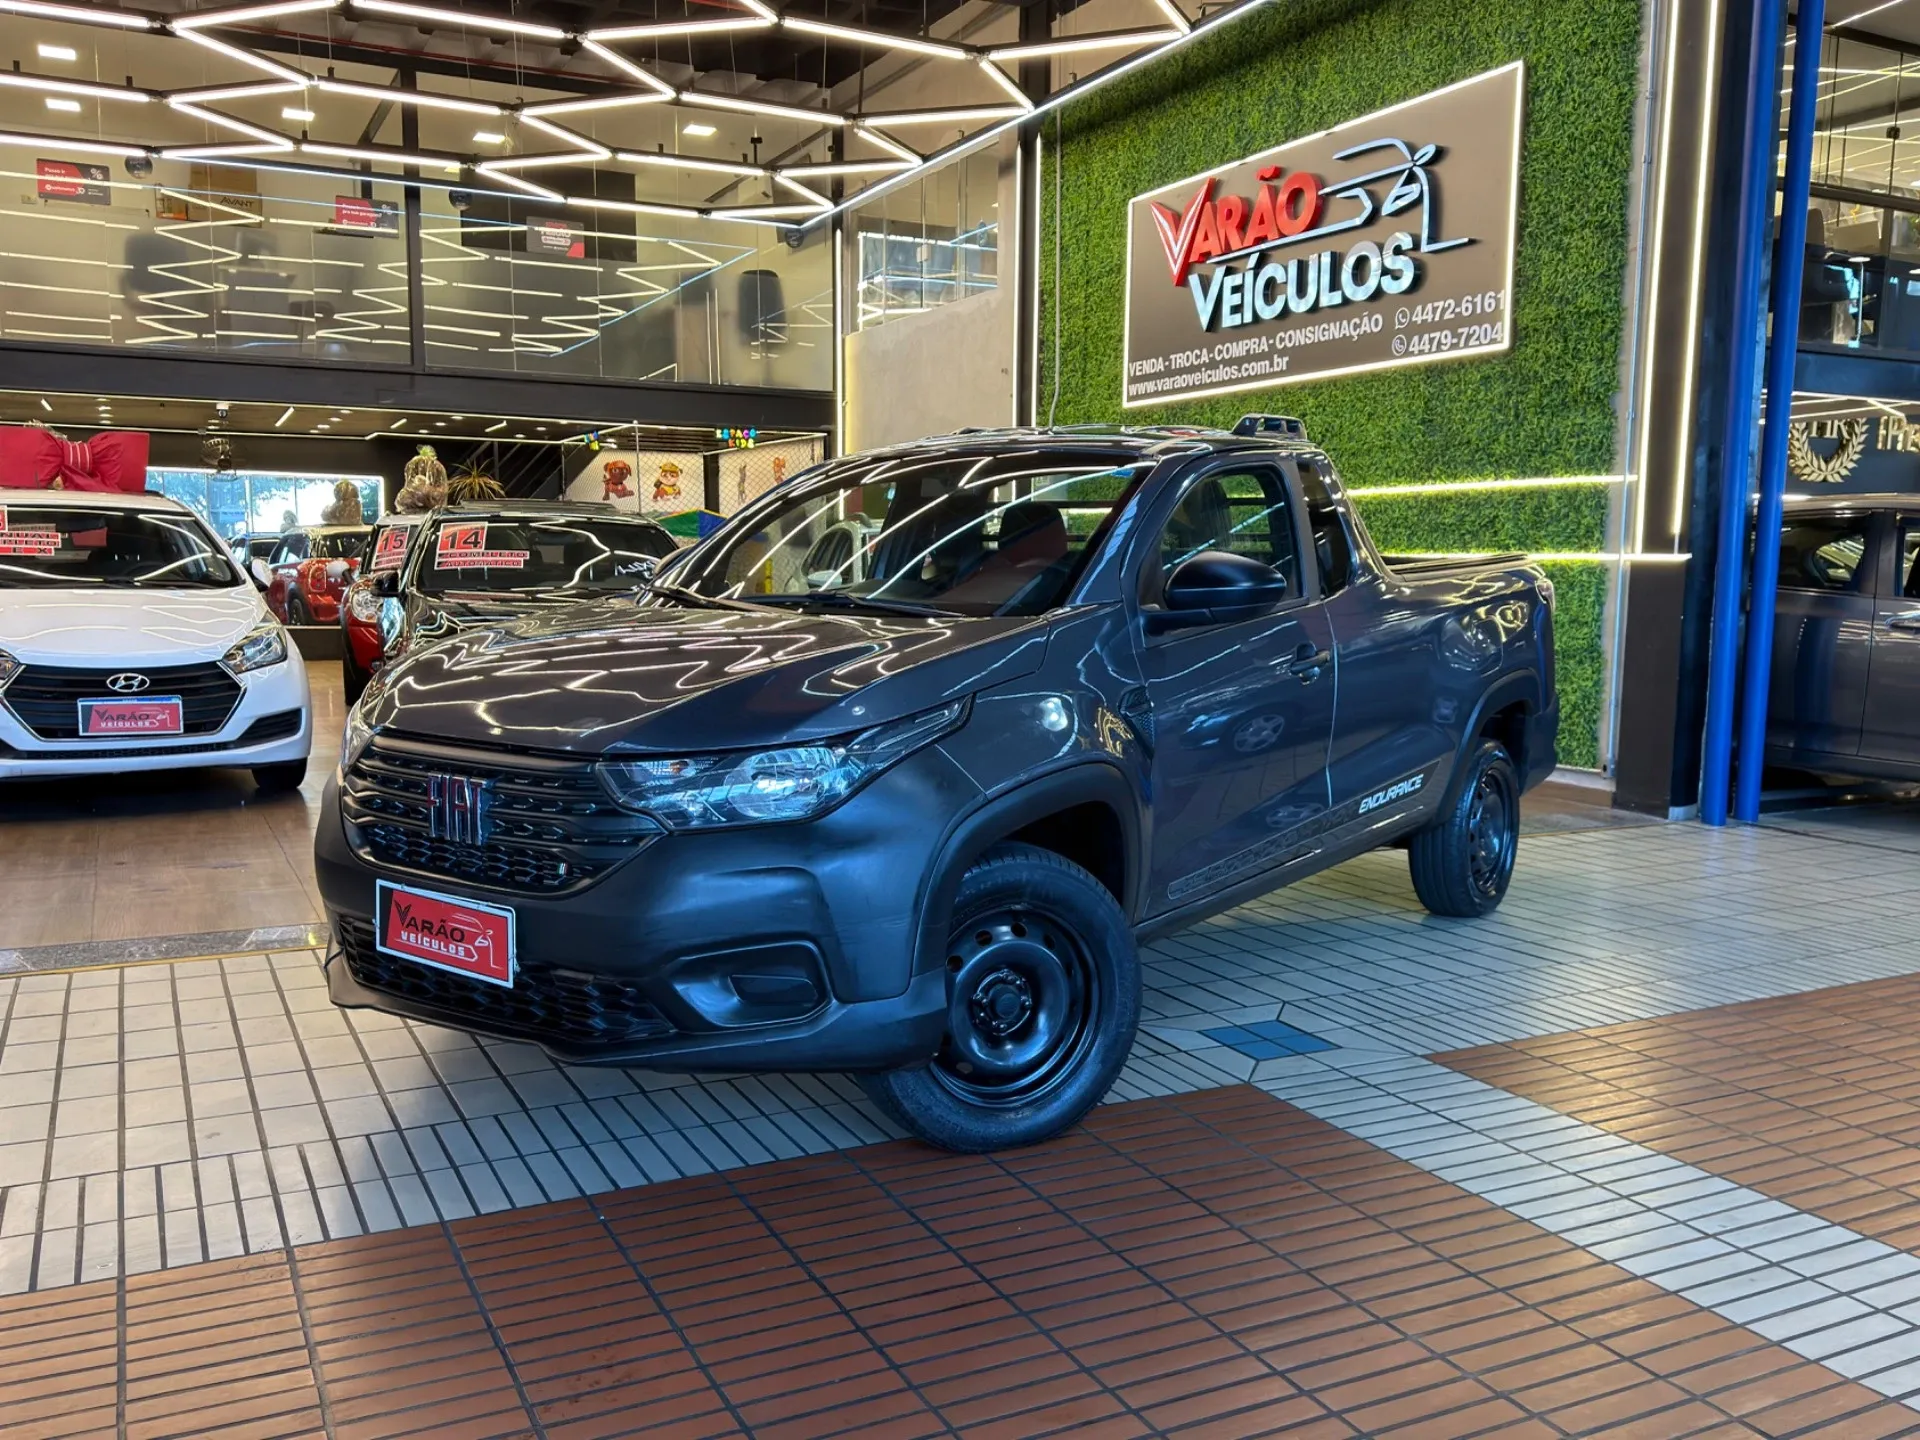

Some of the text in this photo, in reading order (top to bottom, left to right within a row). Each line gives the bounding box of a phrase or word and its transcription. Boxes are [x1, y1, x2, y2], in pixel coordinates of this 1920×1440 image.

[220, 196, 254, 208] AVANT
[1151, 165, 1324, 286] VARÃO
[1188, 231, 1415, 332] VEÍCULOS
[1411, 290, 1506, 325] 4472-6161
[1408, 321, 1504, 355] 4479-7204
[1128, 353, 1290, 396] www.varaoveiculos.com.br
[728, 438, 755, 449] KIDS
[382, 533, 404, 550] 15
[445, 530, 481, 549] 14
[94, 708, 149, 721] VARÃO
[100, 720, 151, 728] VEÍCULOS
[427, 773, 486, 845] FIAT
[1359, 774, 1424, 814] ENDURANCE
[394, 900, 465, 943] VARÃO
[401, 931, 465, 957] VEÍCULOS
